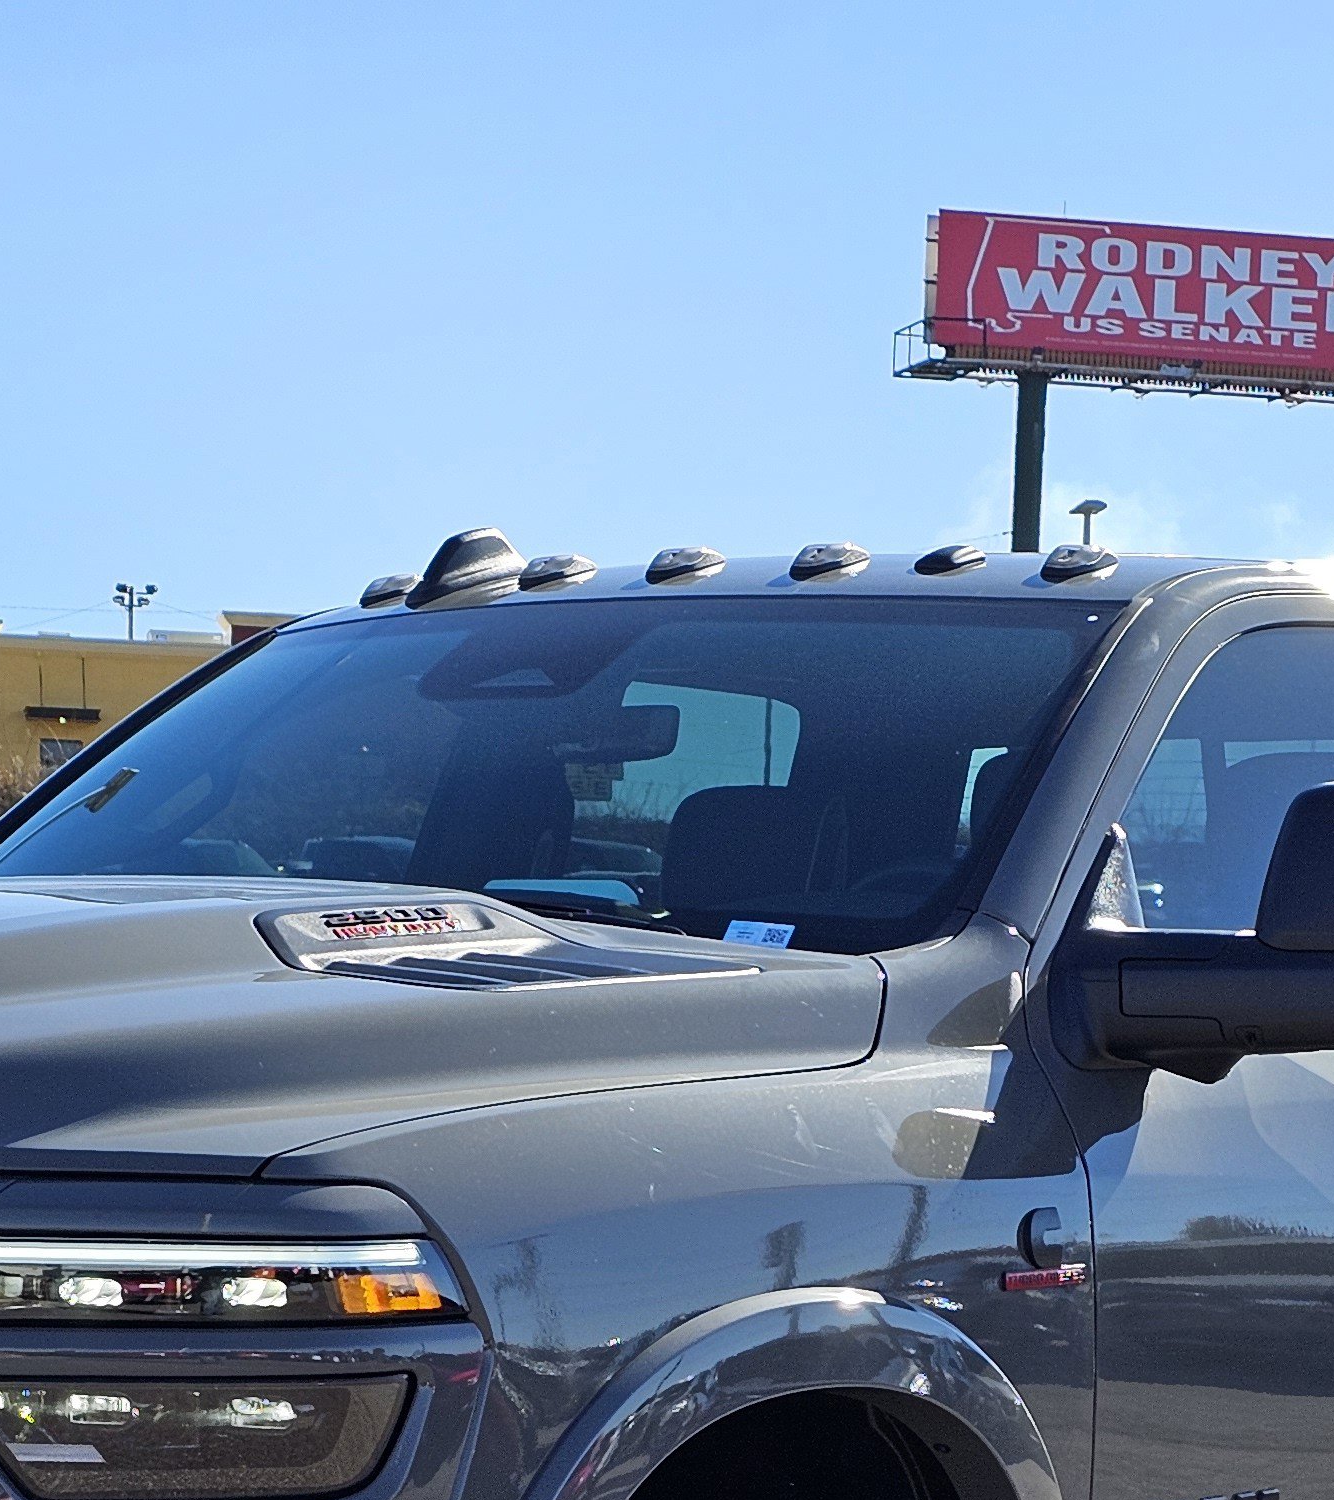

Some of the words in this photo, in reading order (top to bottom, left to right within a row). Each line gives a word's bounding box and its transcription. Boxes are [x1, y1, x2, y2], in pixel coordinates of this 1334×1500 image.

[1063, 315, 1125, 336] US
[1138, 321, 1317, 349] SENATE
[320, 906, 449, 928] 2500
